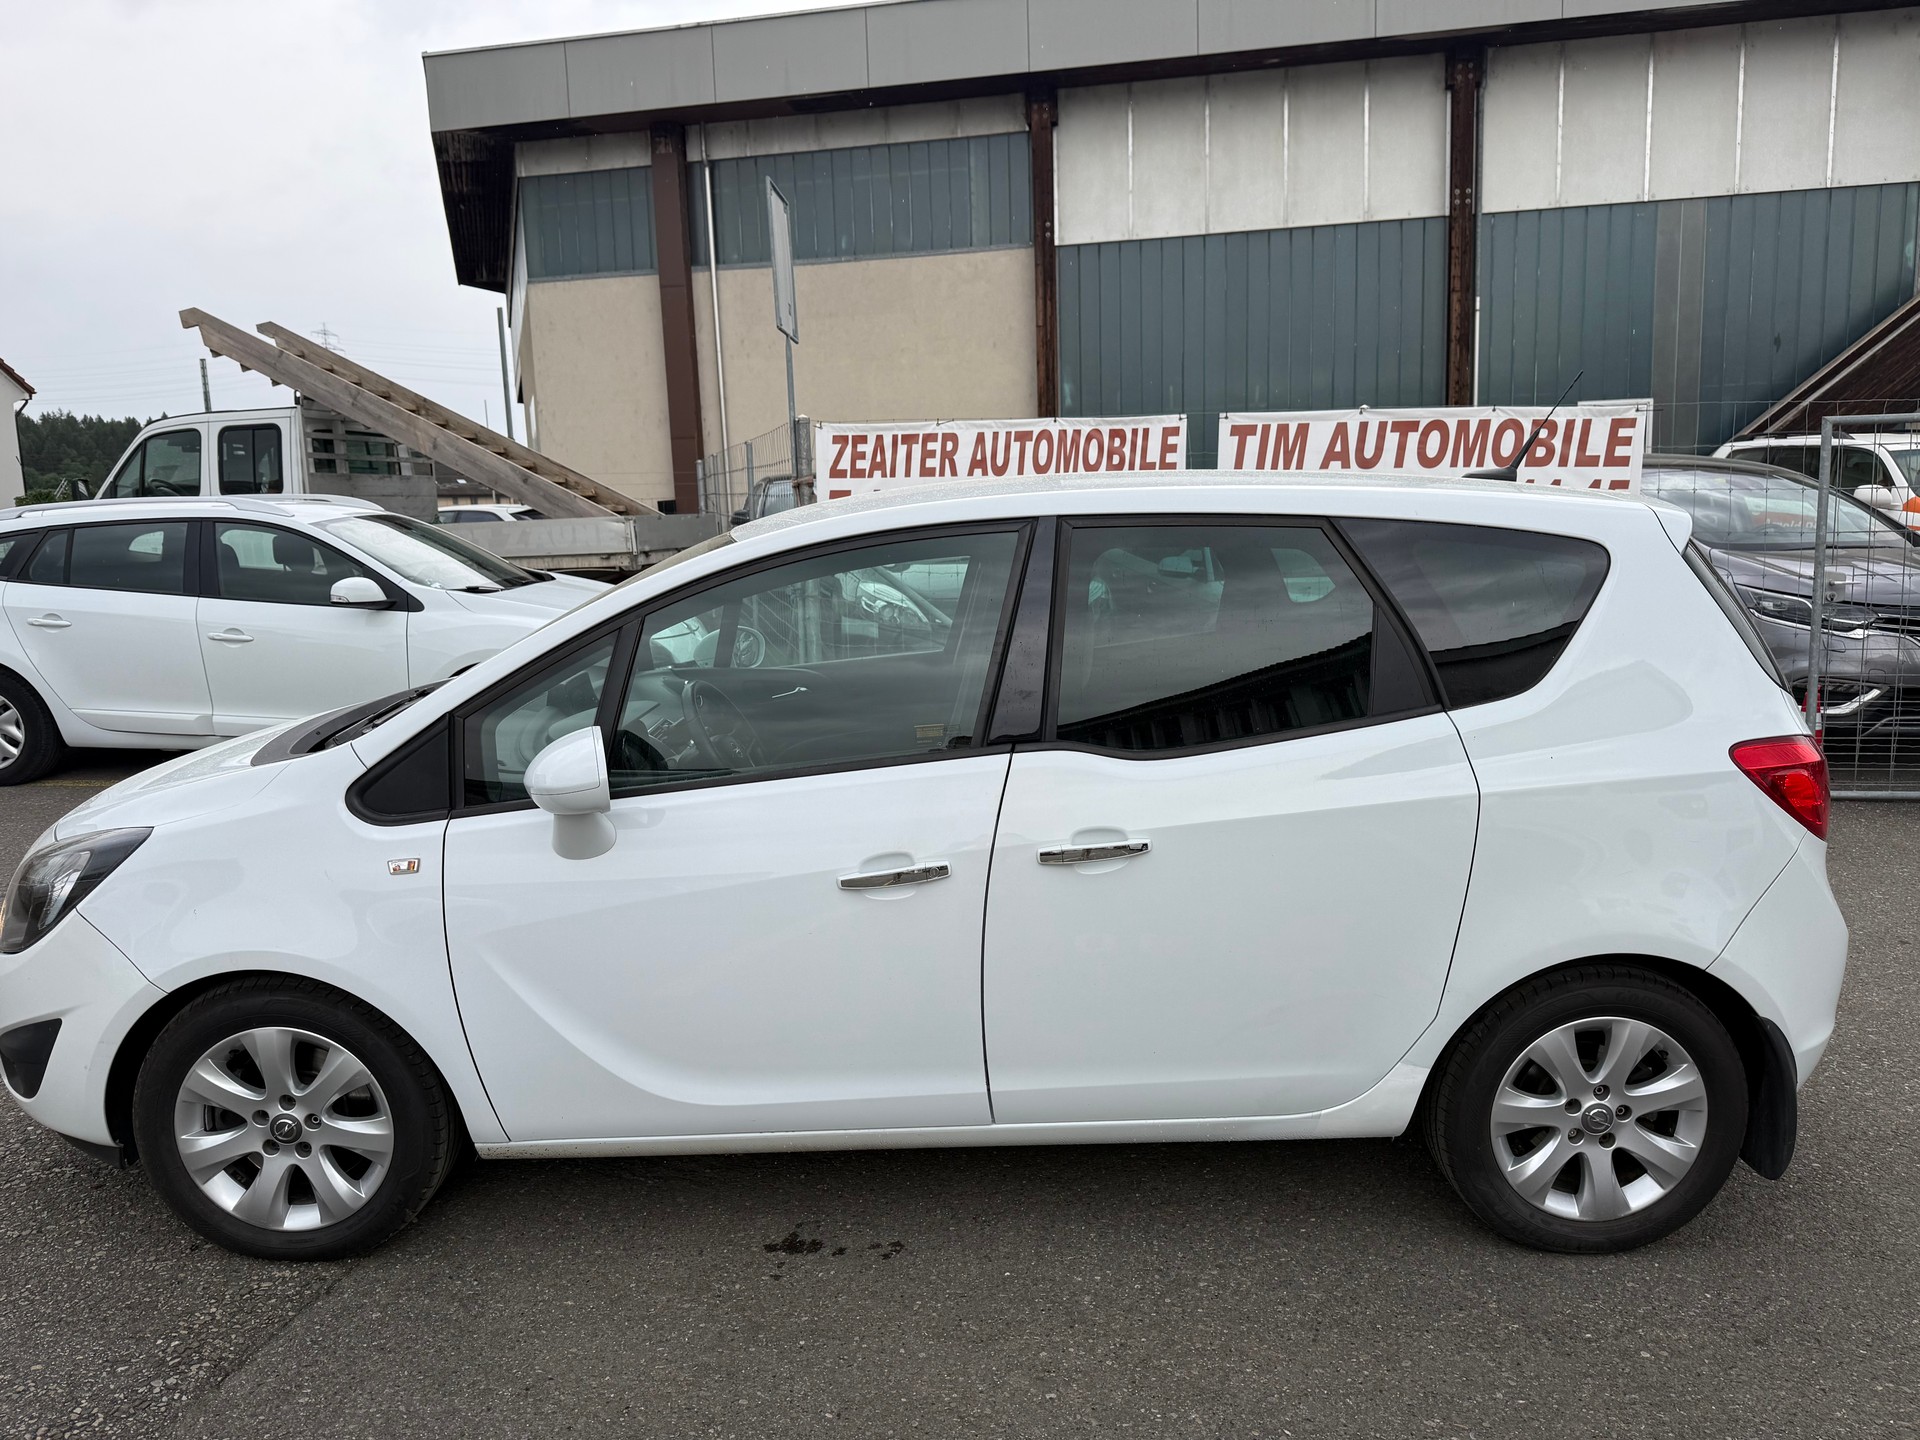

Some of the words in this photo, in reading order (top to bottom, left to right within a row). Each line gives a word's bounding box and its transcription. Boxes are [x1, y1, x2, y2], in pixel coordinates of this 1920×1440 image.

[829, 432, 959, 479] ZEAITER
[967, 426, 1181, 477] AUTOMOBILE
[1229, 421, 1310, 470] TIM
[1320, 417, 1637, 470] AUTOMOBILE
